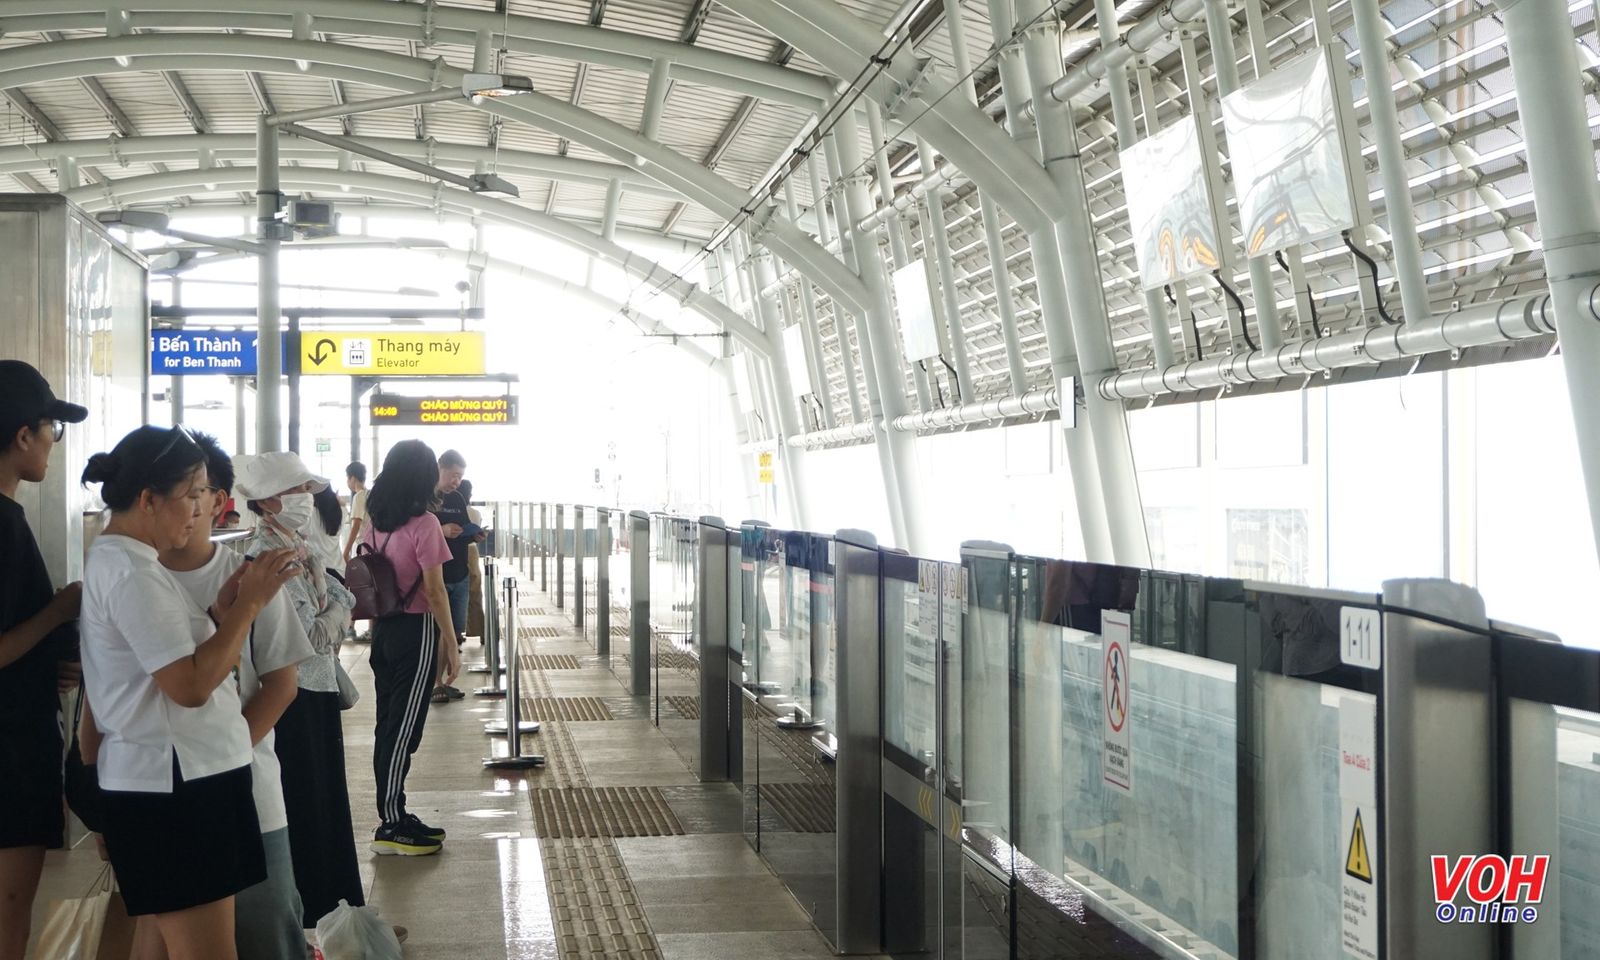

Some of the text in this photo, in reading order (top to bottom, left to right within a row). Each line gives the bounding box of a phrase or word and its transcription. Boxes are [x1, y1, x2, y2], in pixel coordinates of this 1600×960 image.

[159, 335, 190, 352] Bến
[193, 336, 242, 352] Thành
[377, 338, 461, 356] Thang máy
[164, 356, 242, 368] for Ben Thanh
[377, 357, 420, 368] Elevator
